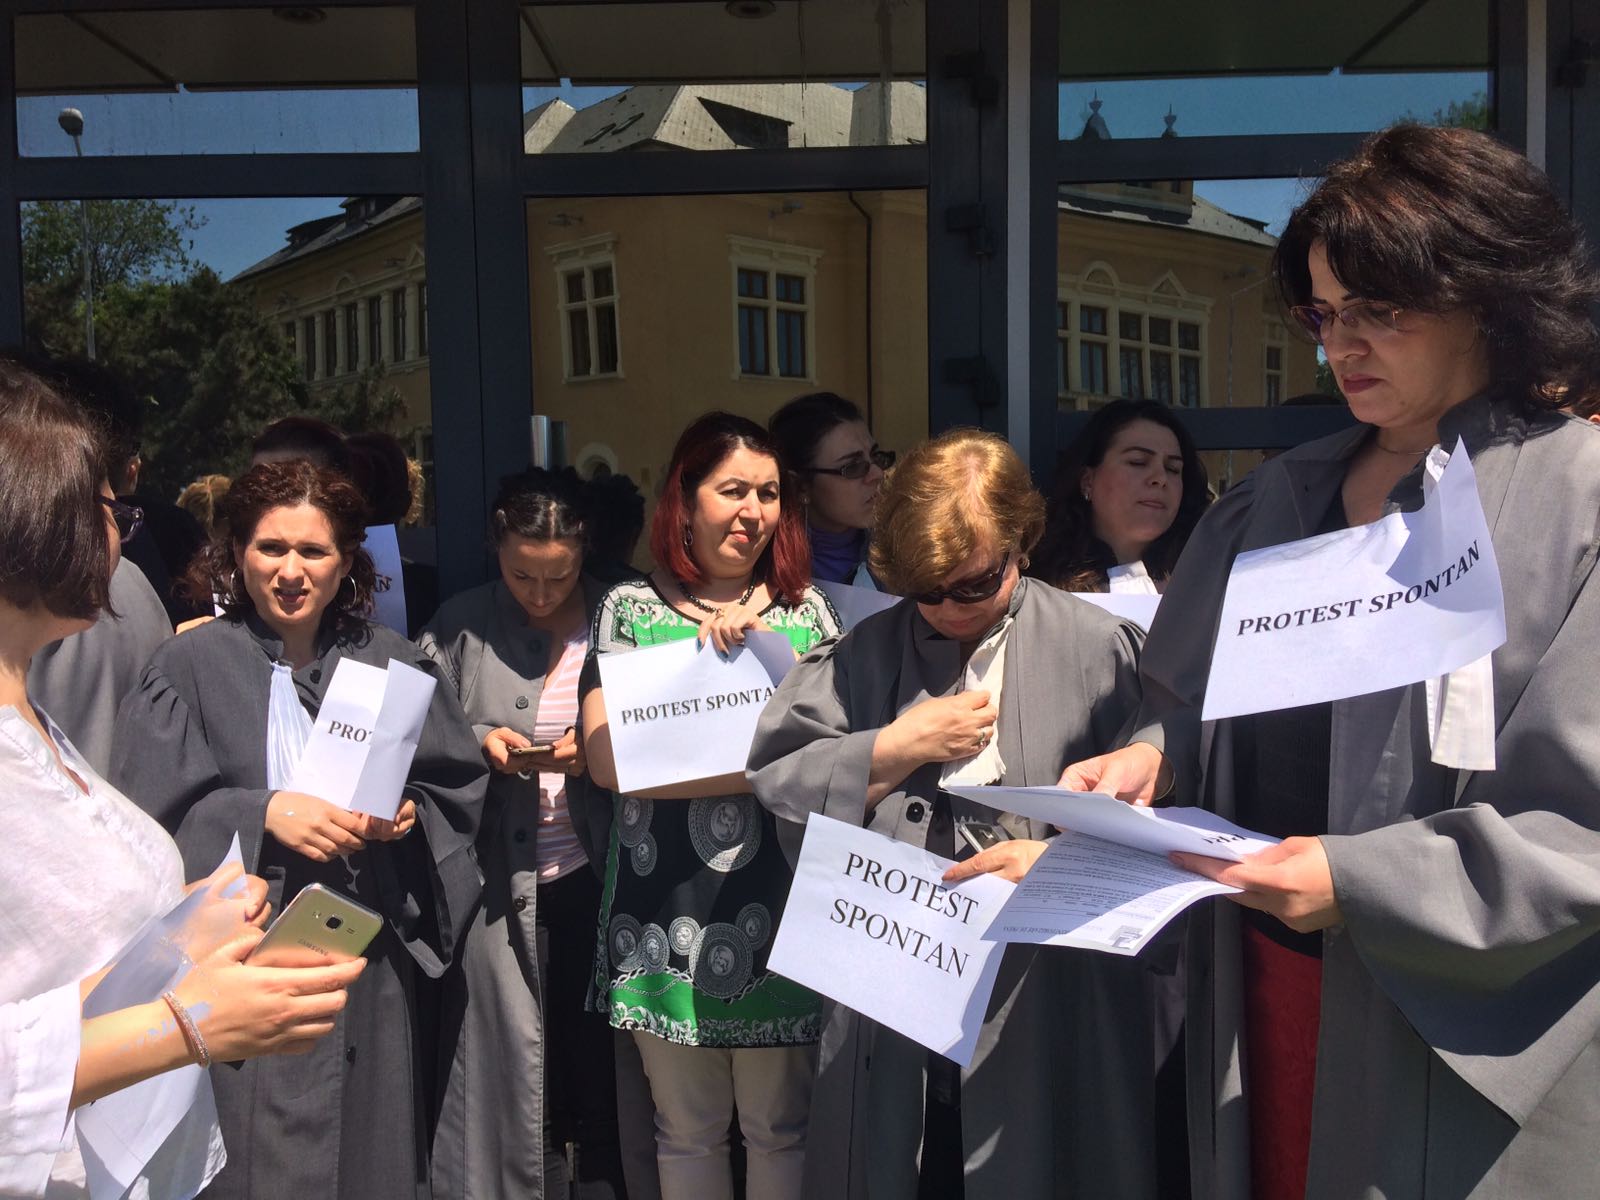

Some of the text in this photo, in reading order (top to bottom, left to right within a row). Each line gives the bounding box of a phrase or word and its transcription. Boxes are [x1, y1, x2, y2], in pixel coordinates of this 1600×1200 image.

[1237, 539, 1480, 636] PROTEST SPONTAN
[328, 720, 372, 742] PRO
[621, 698, 701, 726] PROTEST
[843, 852, 979, 925] PROTEST
[830, 898, 970, 978] SPONTAN
